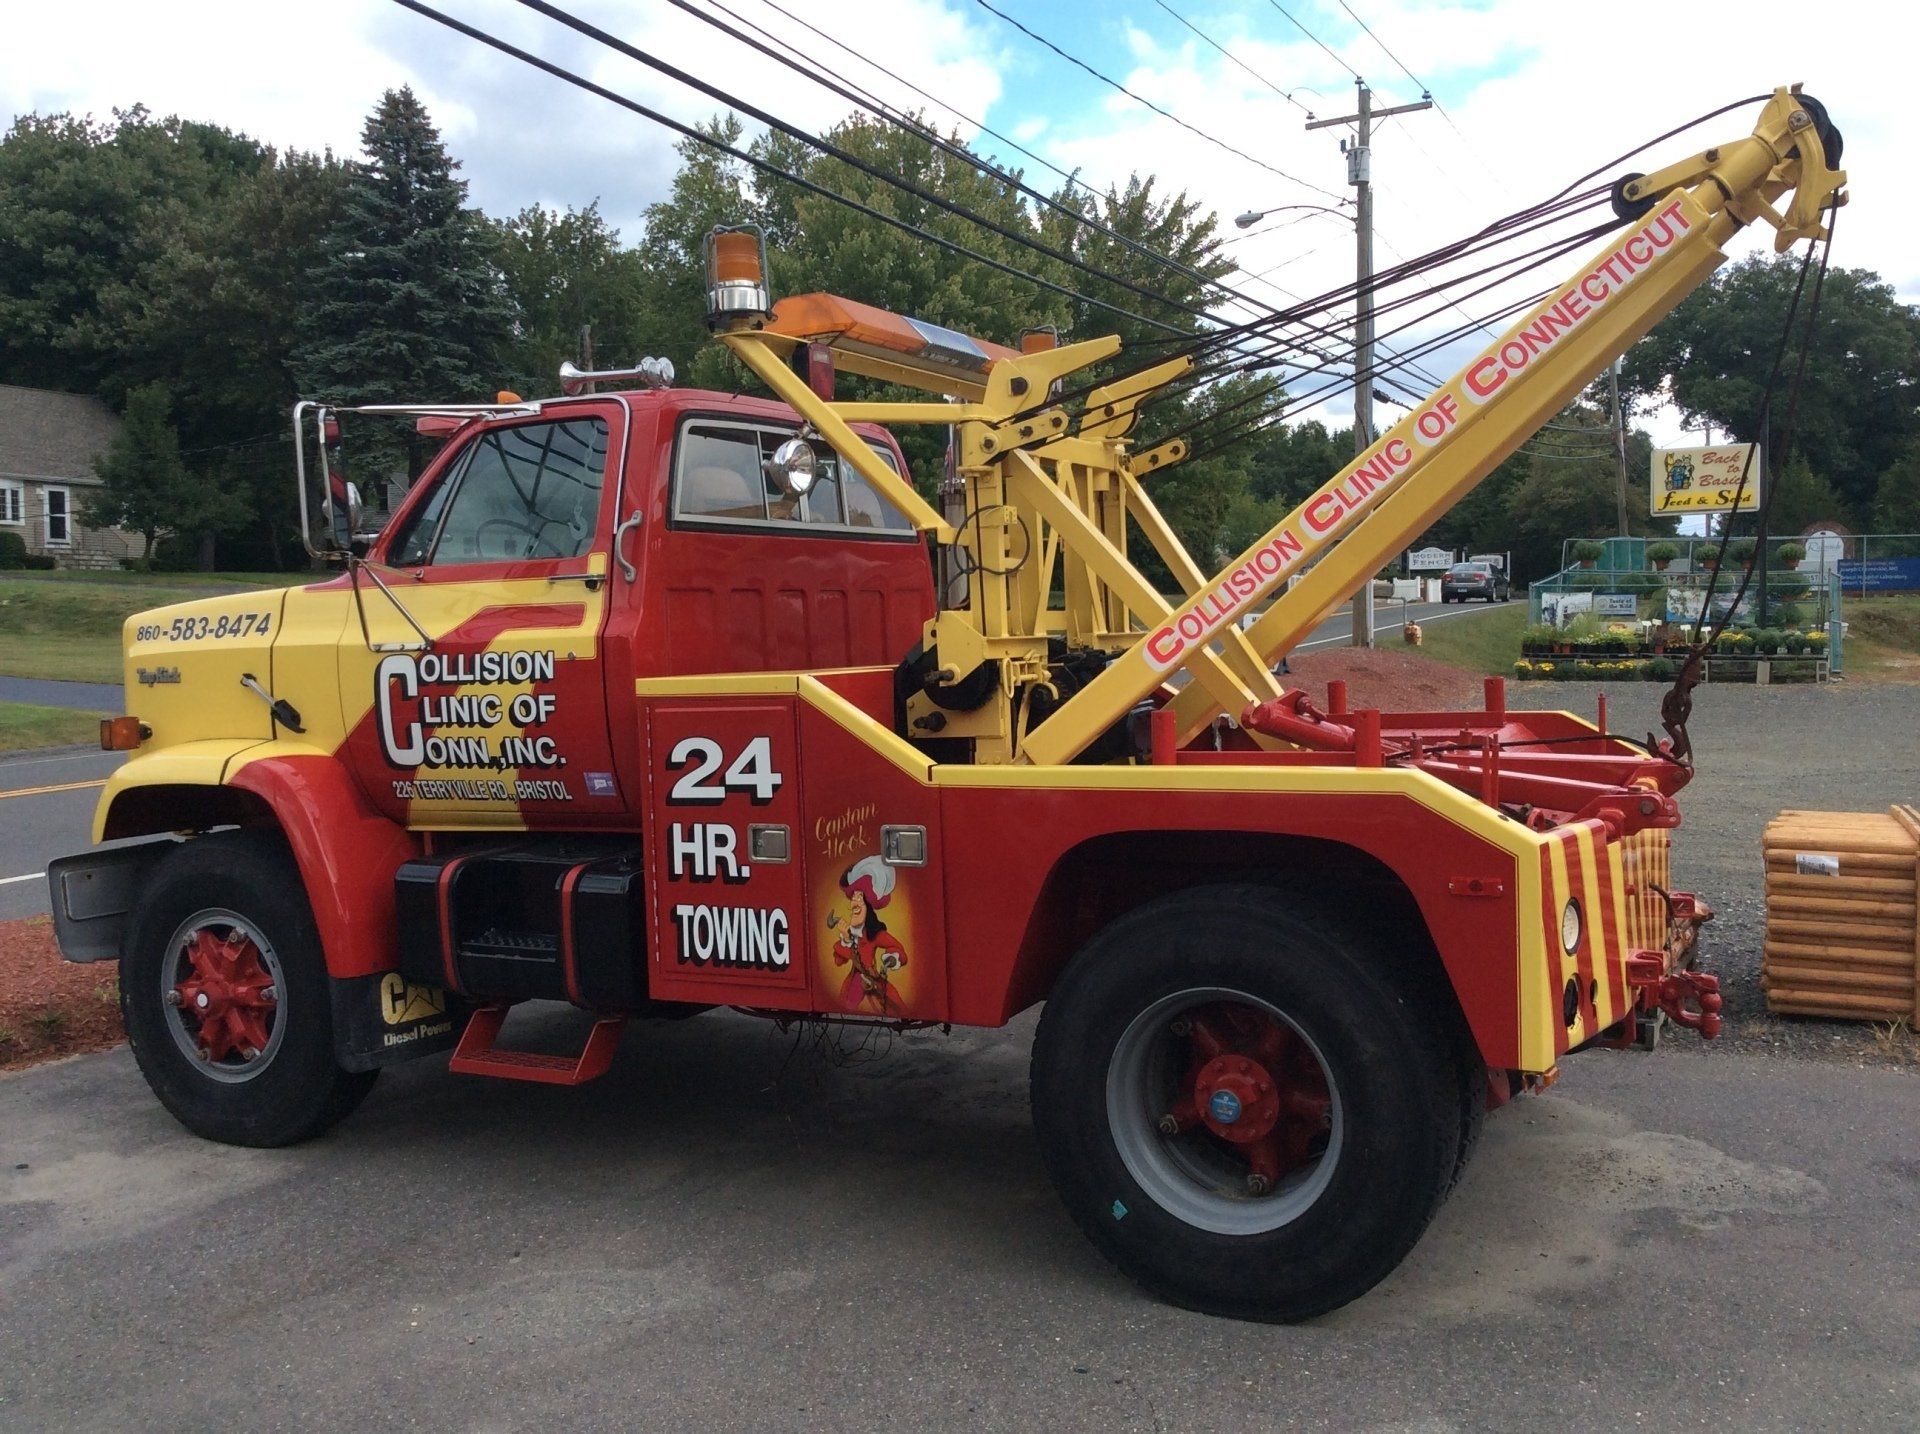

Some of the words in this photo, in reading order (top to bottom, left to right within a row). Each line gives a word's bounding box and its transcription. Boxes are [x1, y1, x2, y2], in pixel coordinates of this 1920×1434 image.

[1146, 530, 1302, 664] COLLISION
[1302, 440, 1412, 534] CLINIC
[1418, 395, 1458, 440] OF
[1464, 202, 1692, 398] CONNECTICUT
[1702, 451, 1741, 464] Back
[1727, 464, 1740, 473] to
[1697, 497, 1708, 505] &
[1715, 490, 1751, 505] Sed
[136, 613, 271, 642] 860-583-8474
[513, 693, 556, 725] OF
[670, 737, 782, 800] 24
[392, 781, 414, 798] 226
[414, 781, 490, 799] TERRYVILLE
[515, 781, 572, 800] BRISTOL
[815, 802, 878, 842] Captain
[671, 823, 750, 877] HR.
[822, 825, 867, 859] Hook
[676, 904, 790, 964] TOWING
[384, 1026, 418, 1047] Diesel
[420, 1022, 452, 1038] Power
